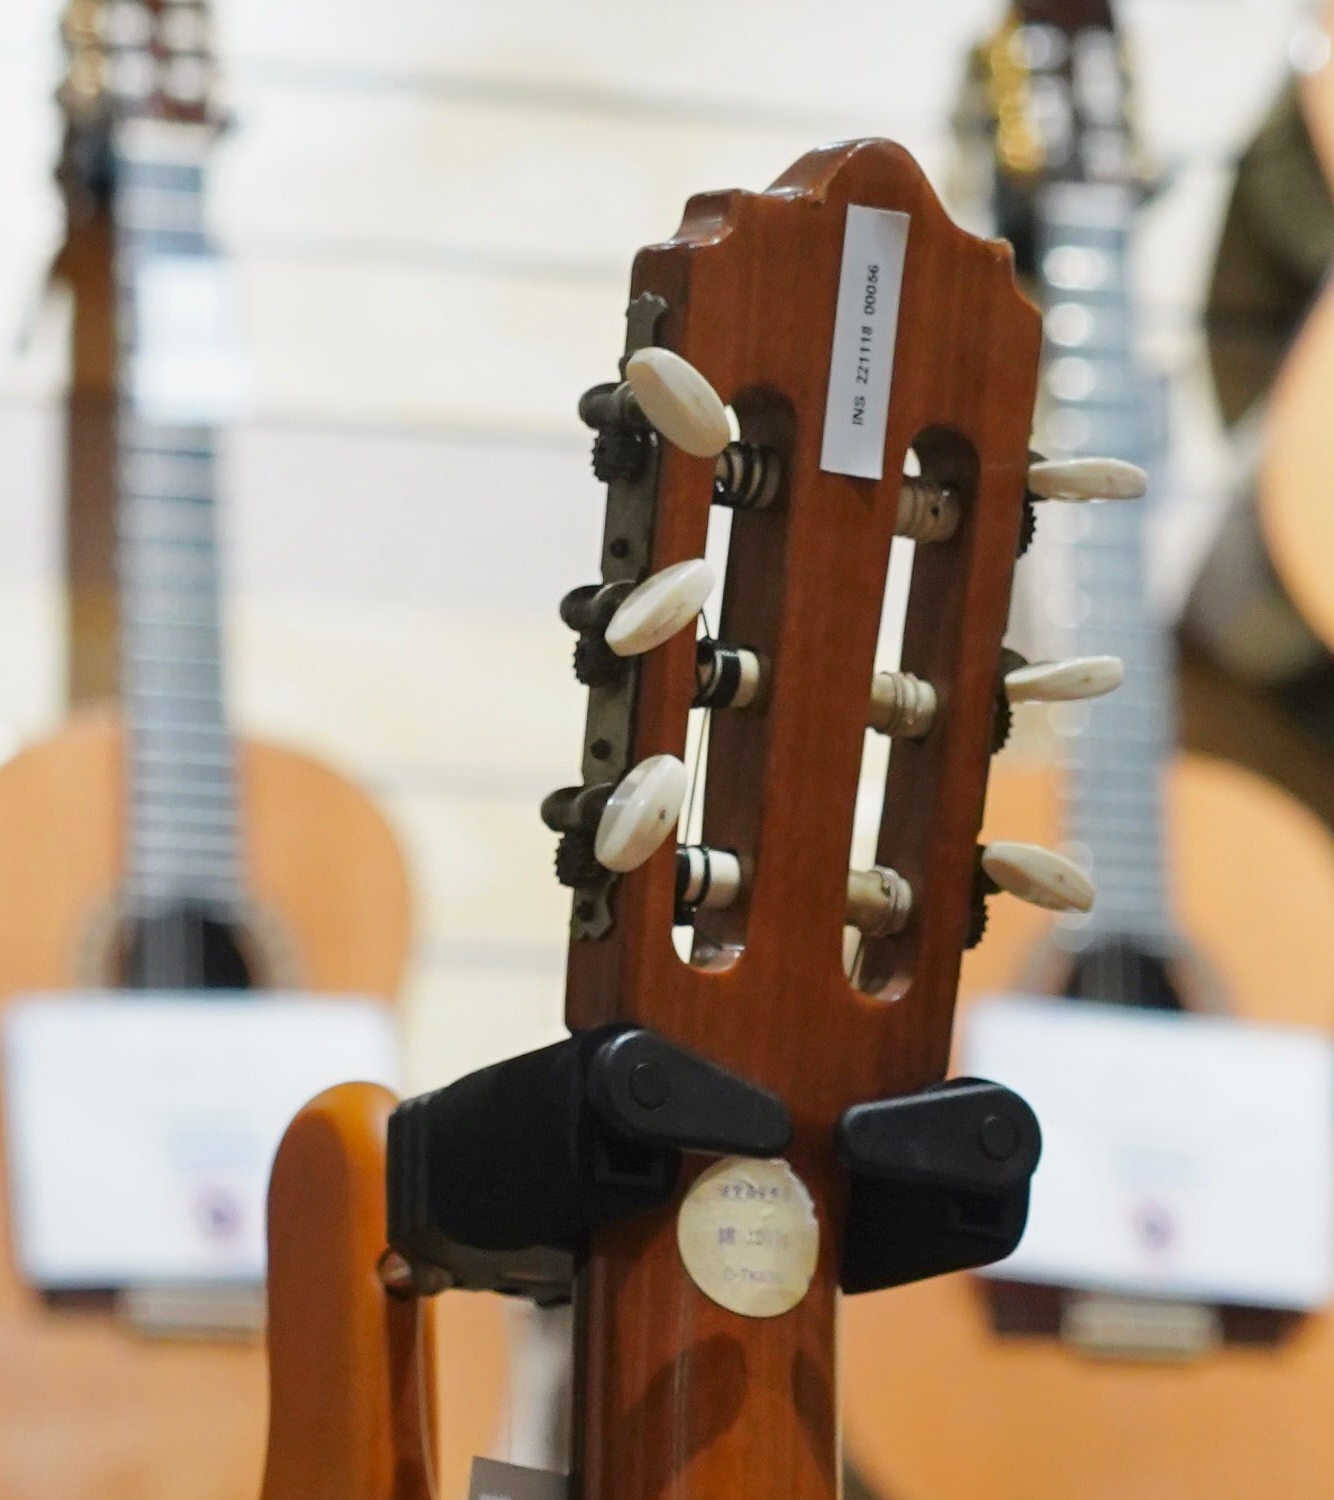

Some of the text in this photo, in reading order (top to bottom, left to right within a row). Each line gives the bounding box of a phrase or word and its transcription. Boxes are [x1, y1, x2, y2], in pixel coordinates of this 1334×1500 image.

[852, 264, 880, 426] INS 221118 00056
